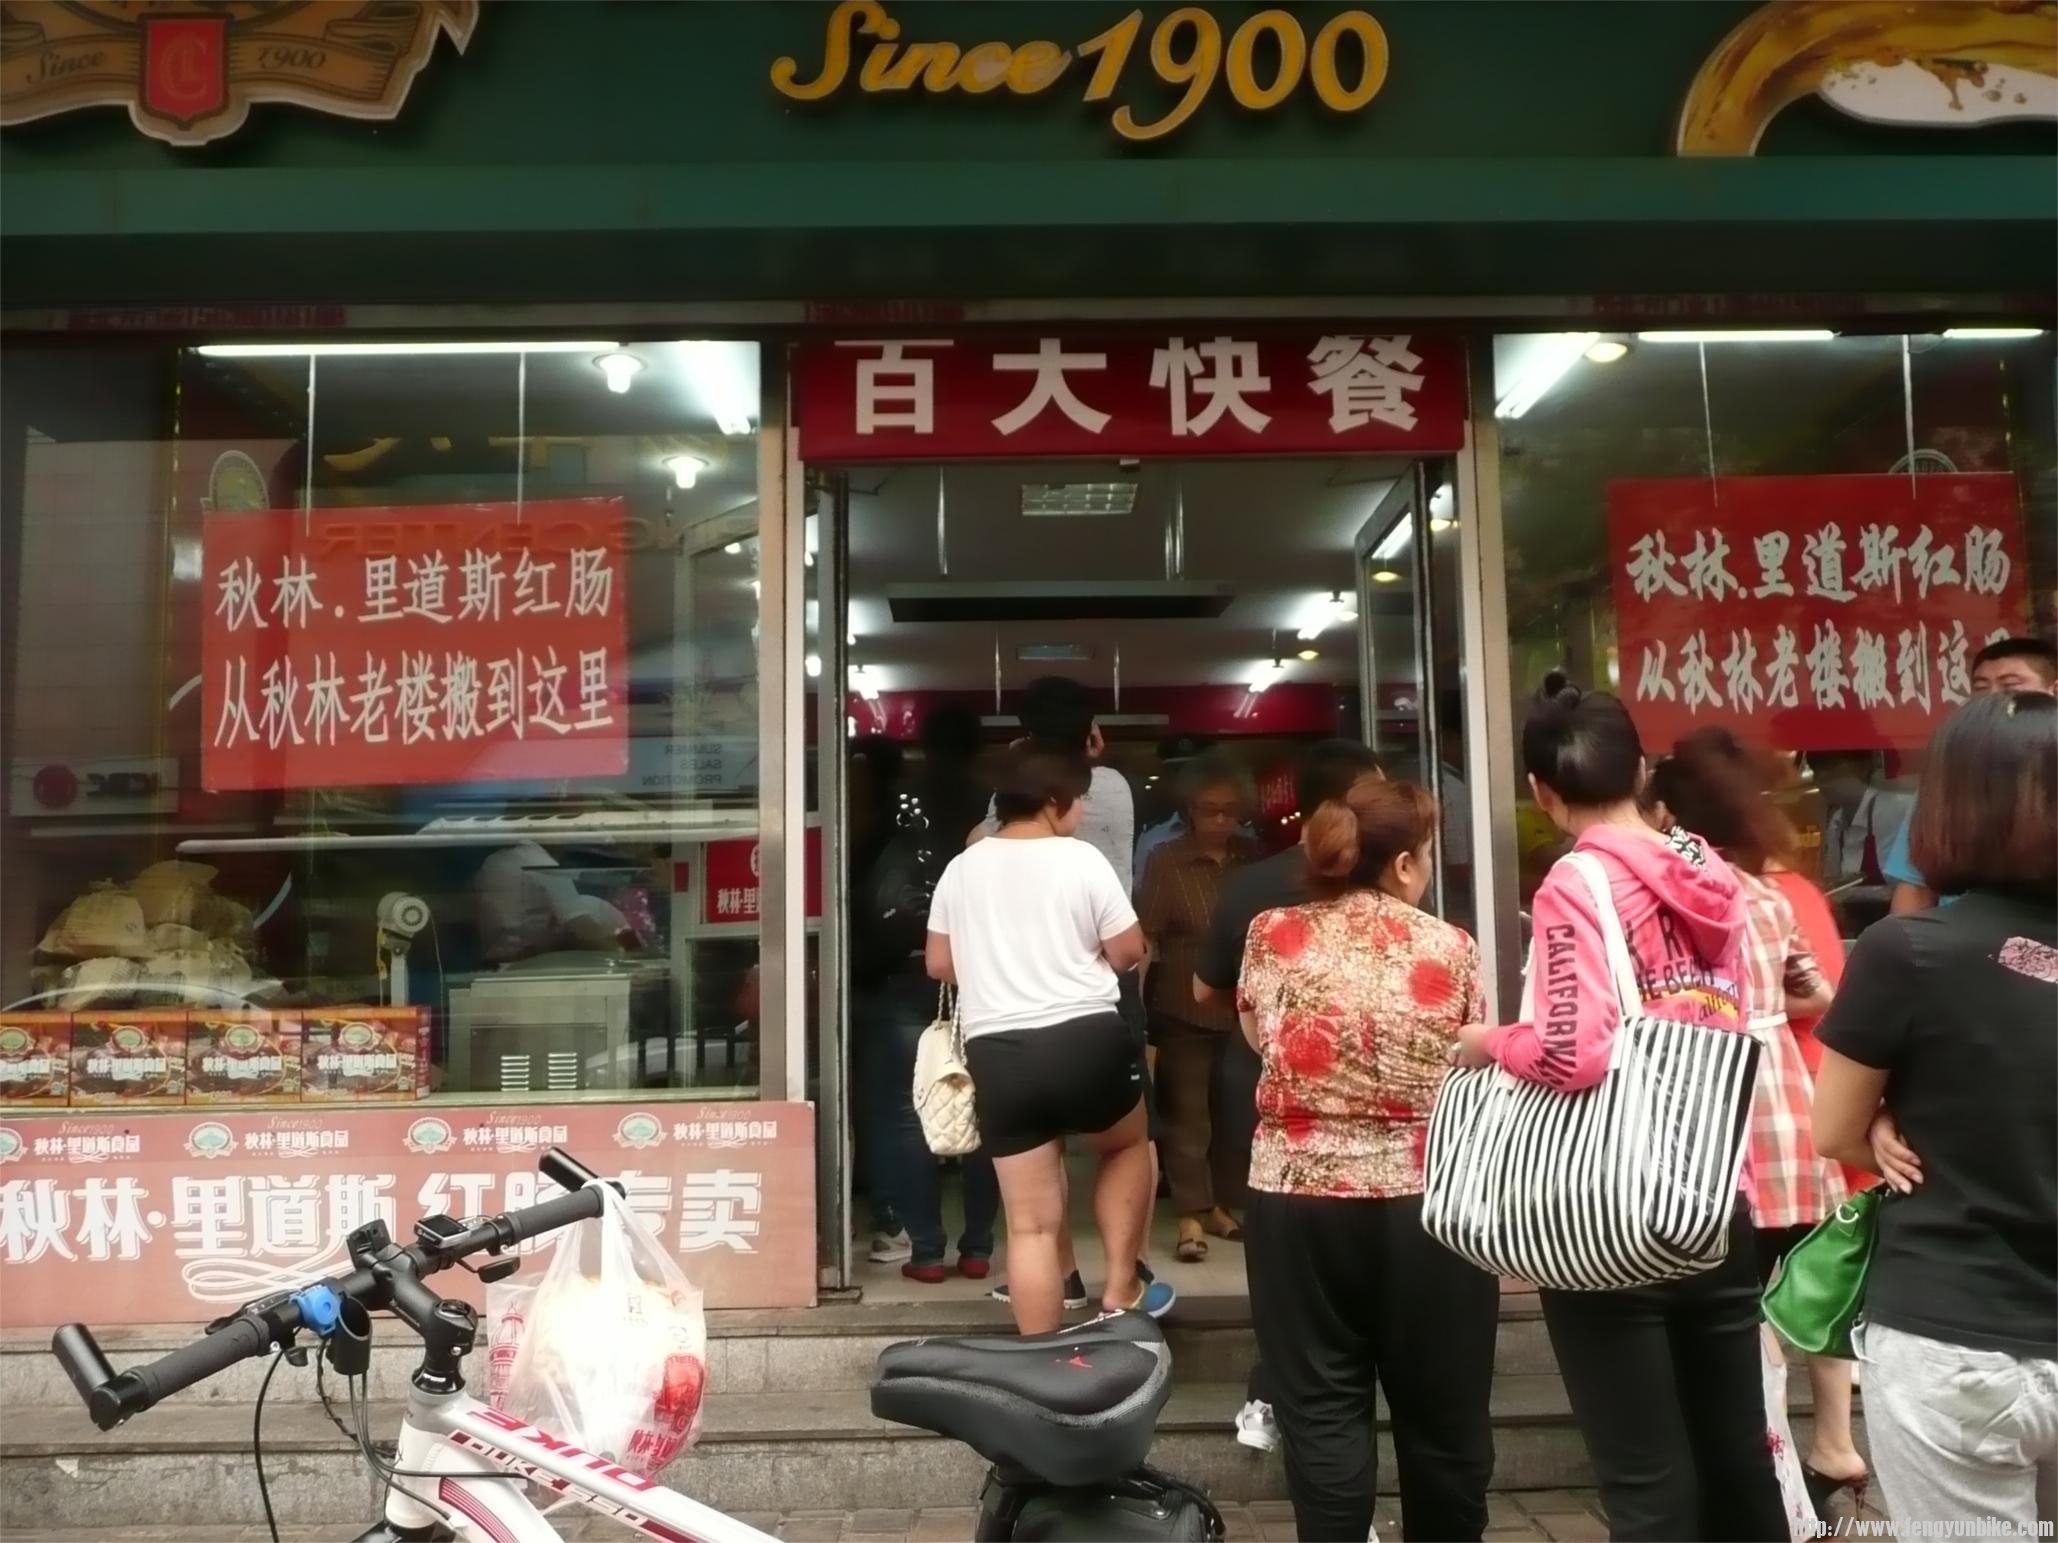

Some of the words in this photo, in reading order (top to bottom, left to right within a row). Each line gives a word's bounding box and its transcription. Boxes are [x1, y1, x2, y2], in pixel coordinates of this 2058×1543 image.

[26, 50, 107, 84] Since
[258, 46, 327, 70] 1900
[834, 334, 1426, 438] 百大快餐
[214, 645, 615, 751] 从秋林老楼搬到这里
[1637, 617, 2012, 716] 从秋林老楼搬到这
[466, 1407, 656, 1492] DUKE
